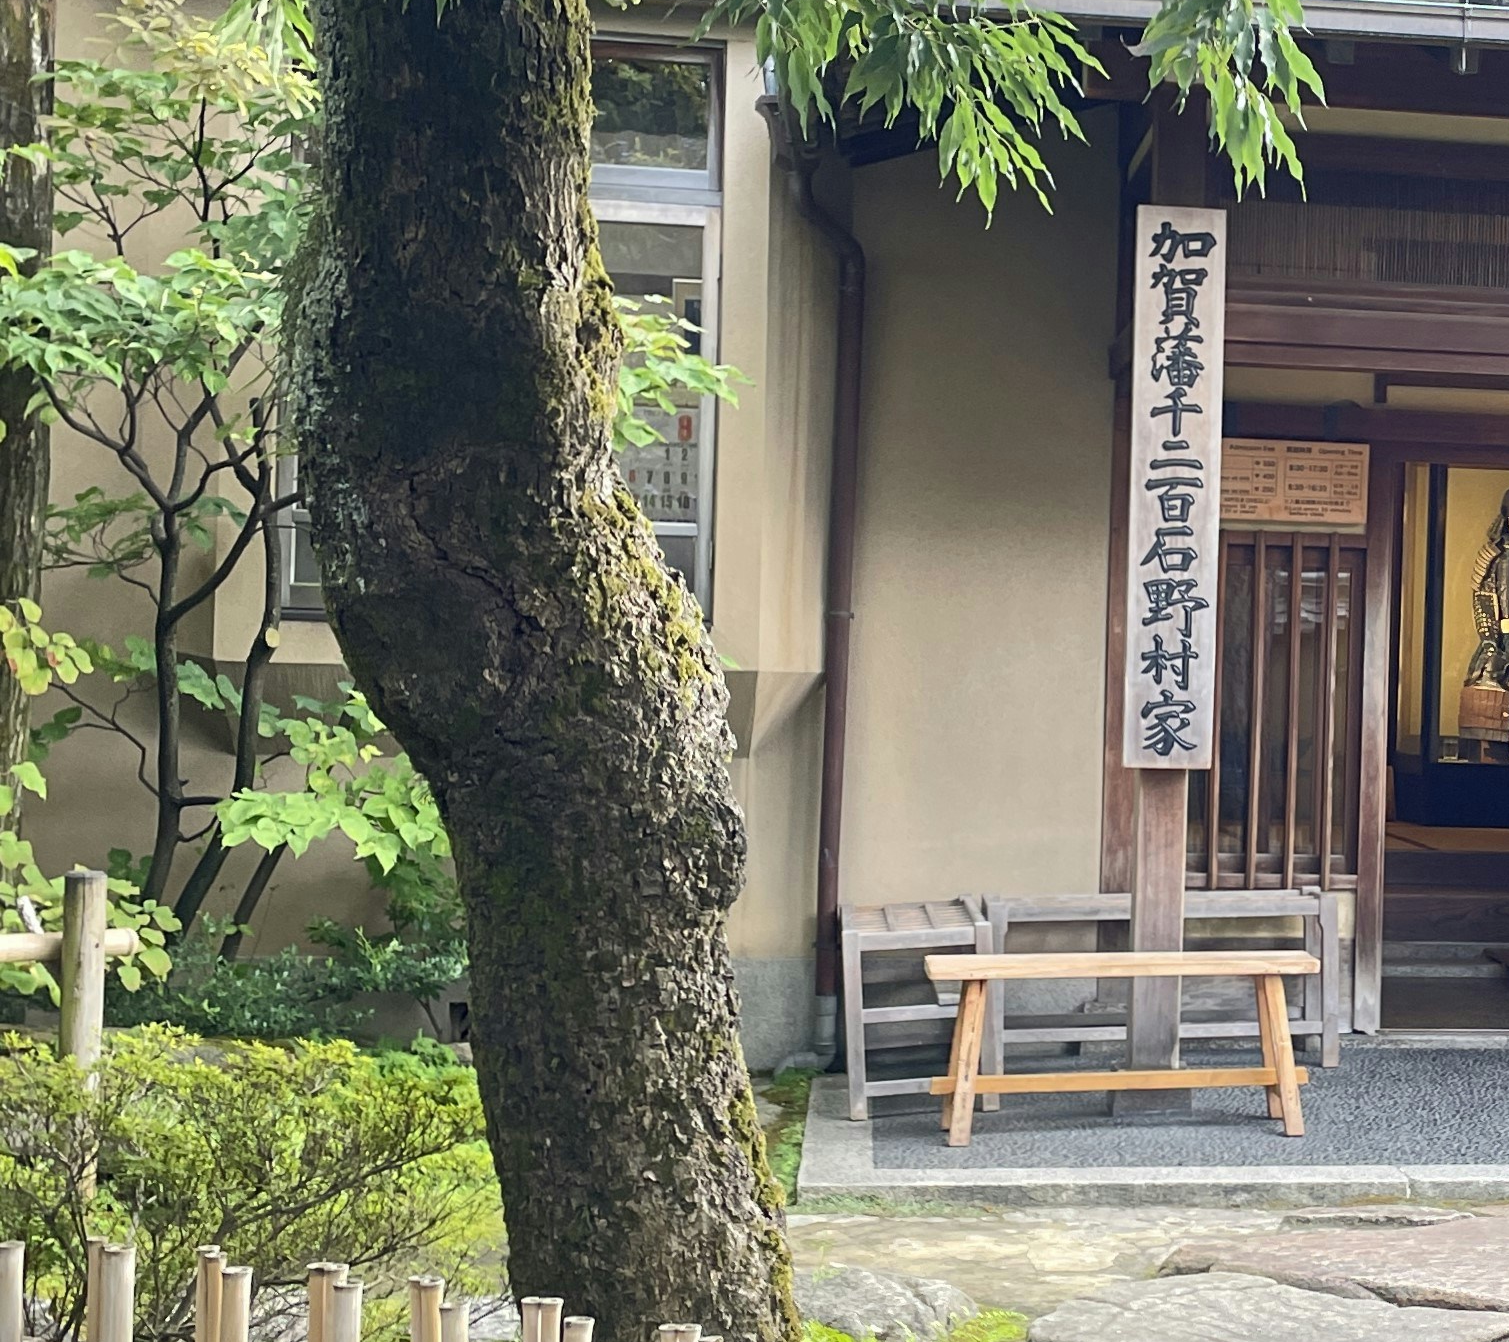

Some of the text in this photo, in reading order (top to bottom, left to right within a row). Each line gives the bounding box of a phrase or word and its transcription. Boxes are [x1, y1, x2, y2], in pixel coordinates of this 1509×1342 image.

[681, 448, 688, 461] 2
[1140, 221, 1217, 757] 加賀藩千二百石野村家
